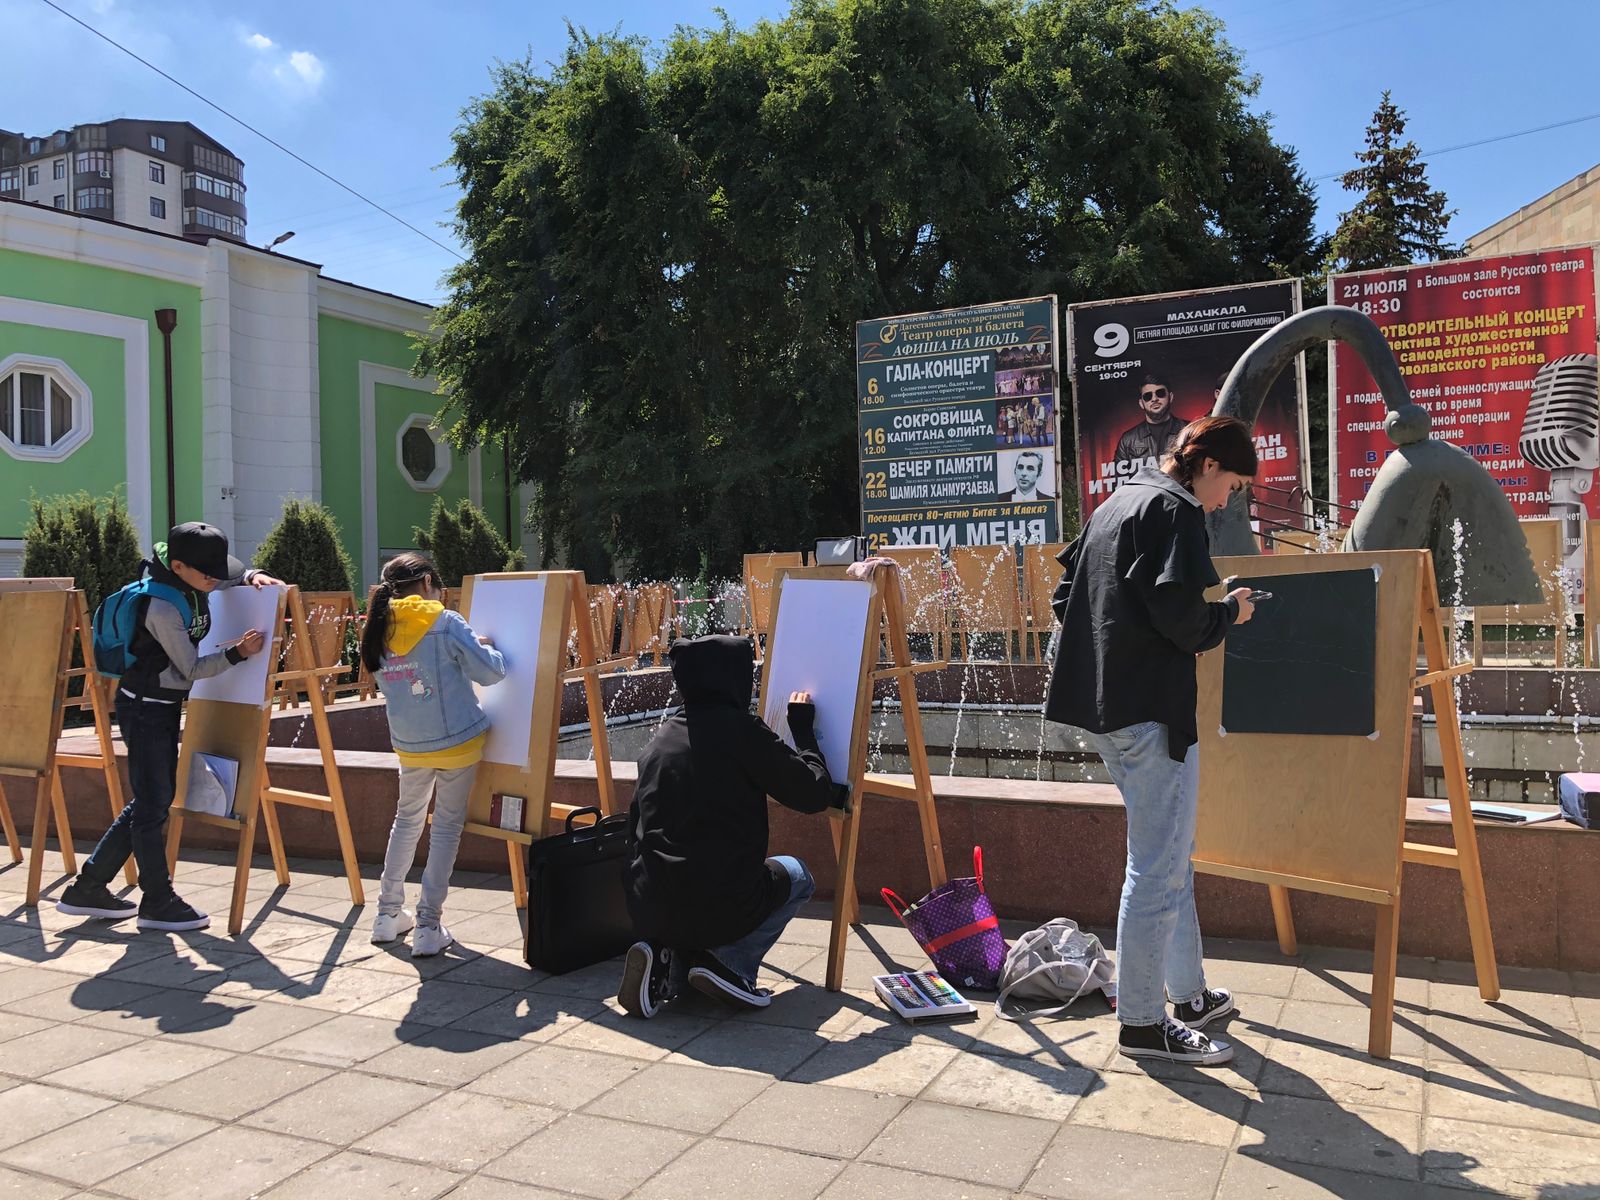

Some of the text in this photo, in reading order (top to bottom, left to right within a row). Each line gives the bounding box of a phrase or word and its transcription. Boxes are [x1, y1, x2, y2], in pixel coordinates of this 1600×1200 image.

[1417, 259, 1585, 288] в Большом зале Русского театра
[1343, 279, 1407, 298] 22 ИЮЛЯ
[1462, 285, 1521, 301] состоится
[899, 309, 1025, 331] Дагестанский государственный
[1167, 305, 1247, 322] МАХАЧКАЛА
[1380, 305, 1586, 338] ОТВОРИТЕЛЬНЫЙ КОНЦЕРТ
[901, 319, 1024, 343] Театр оперы и балета
[1137, 328, 1161, 340] ЛЕТНЯЯ
[1161, 324, 1199, 337] ПЛОЩАДКА
[1199, 321, 1216, 333] «ДАГ
[1218, 320, 1230, 330] ГОС
[1388, 320, 1569, 351] лектива художественной
[892, 332, 1019, 358] АФИША НА ИЮЛЬ
[1094, 323, 1130, 358] 9
[1400, 339, 1535, 363] самодеятельности
[886, 355, 990, 383] ГАЛА-КОНЦЕРТ
[1084, 360, 1142, 373] СЕНТЯБРЯ
[1399, 351, 1546, 376] оволакского района
[1099, 370, 1128, 380] 19:00
[867, 378, 879, 395] 6
[1346, 395, 1351, 404] в
[1410, 384, 1441, 399] семей
[1444, 379, 1541, 397] военнослужащих,
[863, 395, 885, 405] 18.00
[1435, 401, 1448, 411] во
[1450, 398, 1482, 413] время
[893, 408, 984, 430] СОКРОВИЩА
[1431, 413, 1457, 426] нной
[1460, 411, 1510, 426] операции
[864, 427, 886, 446] 16
[887, 429, 945, 443] КАПИТАНА
[947, 424, 995, 438] ФЛИНТА
[1428, 428, 1464, 441] краине
[864, 445, 886, 455] 12.00
[1366, 450, 1377, 463] В
[889, 455, 993, 478] ВЕЧЕР ПАМЯТИ
[1350, 467, 1380, 478] песн
[865, 472, 887, 489] 22
[889, 480, 995, 500] ШАМИЛЯ ХАНМУРЗАЕВА
[865, 489, 888, 499] 18.00
[1505, 491, 1554, 504] страды
[869, 533, 889, 550] 25
[967, 519, 1046, 545] МЕНЯ
